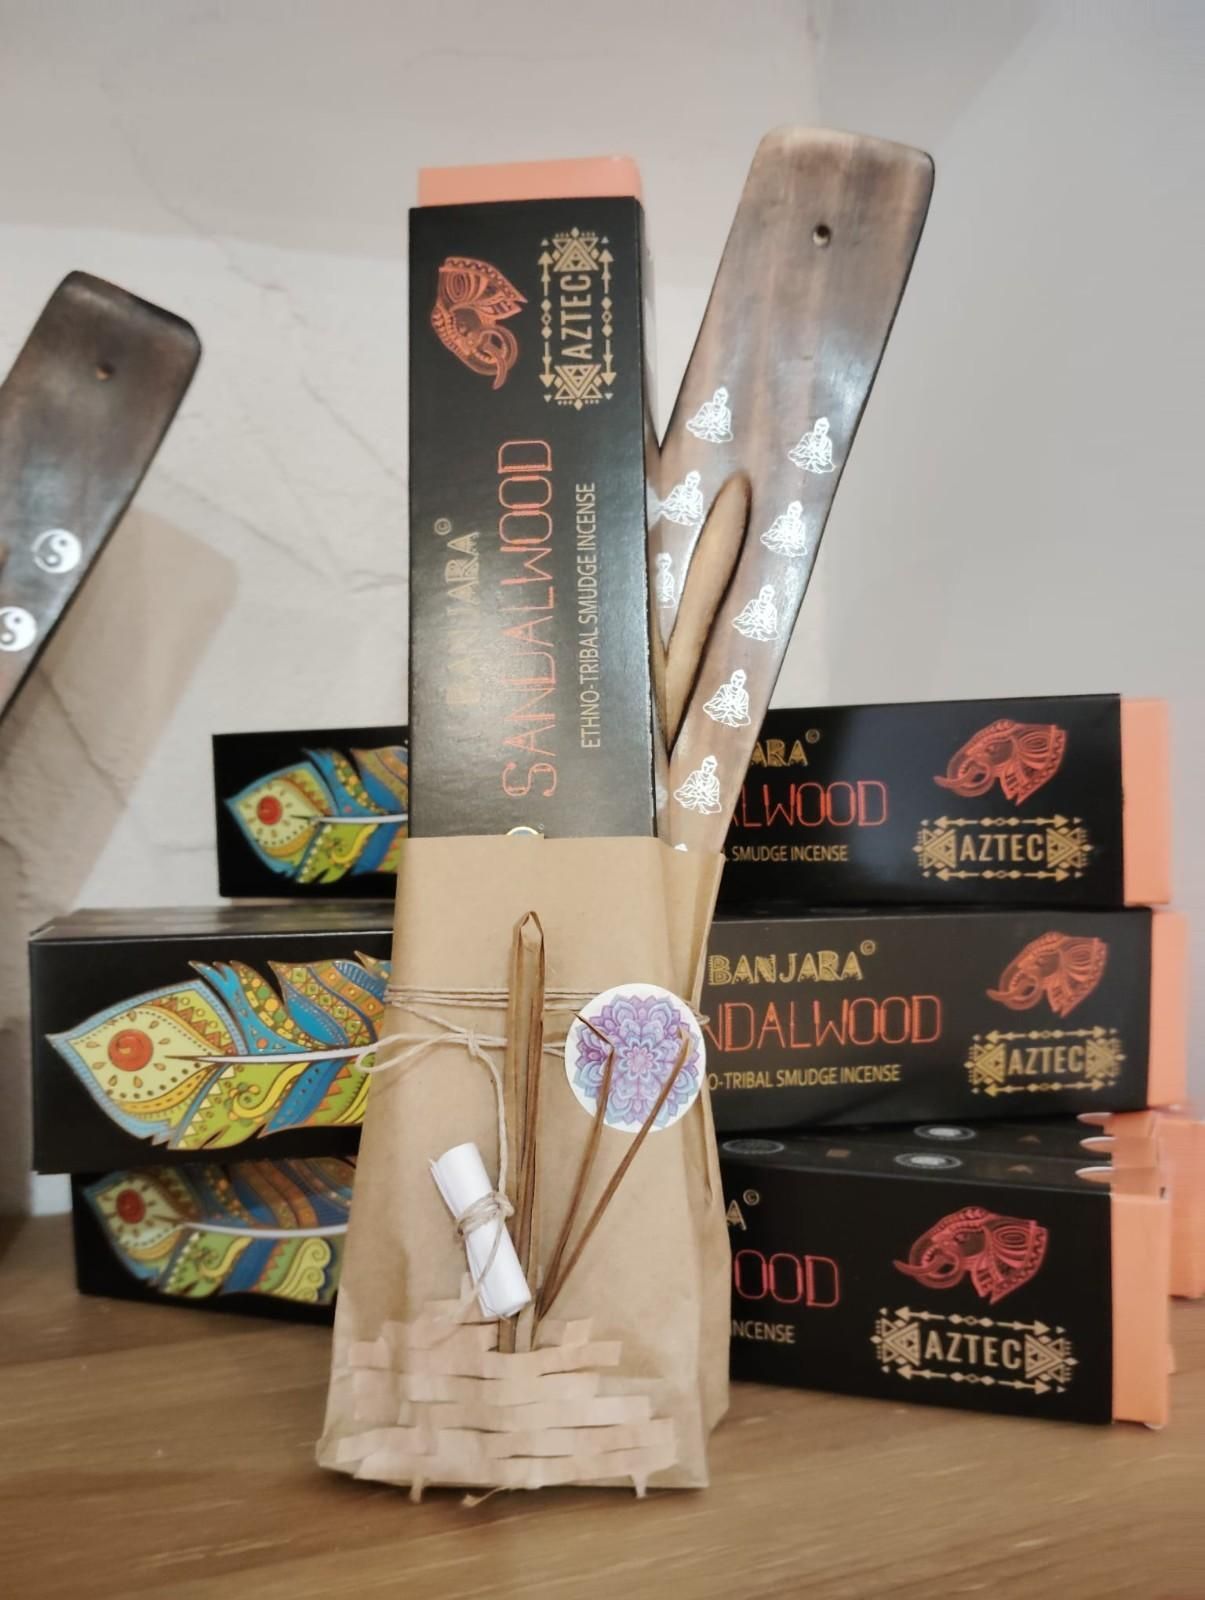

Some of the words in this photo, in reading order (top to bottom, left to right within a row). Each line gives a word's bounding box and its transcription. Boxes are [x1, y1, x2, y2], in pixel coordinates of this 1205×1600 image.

[559, 273, 593, 360] AZTEC
[575, 482, 597, 551] INCENSE
[577, 554, 599, 625] SMUDGE
[497, 440, 557, 798] SANDALWOOD
[579, 627, 601, 749] ETHNO-TRIBAL
[731, 845, 787, 862] SMUDGE
[790, 844, 849, 862] INCENSE
[960, 832, 1045, 862] AZTEC
[776, 1066, 838, 1087] SMUDGE
[840, 1063, 902, 1084] INCENSE
[1008, 1045, 1085, 1076] AZTEC
[924, 1328, 1023, 1370] AZTEC
